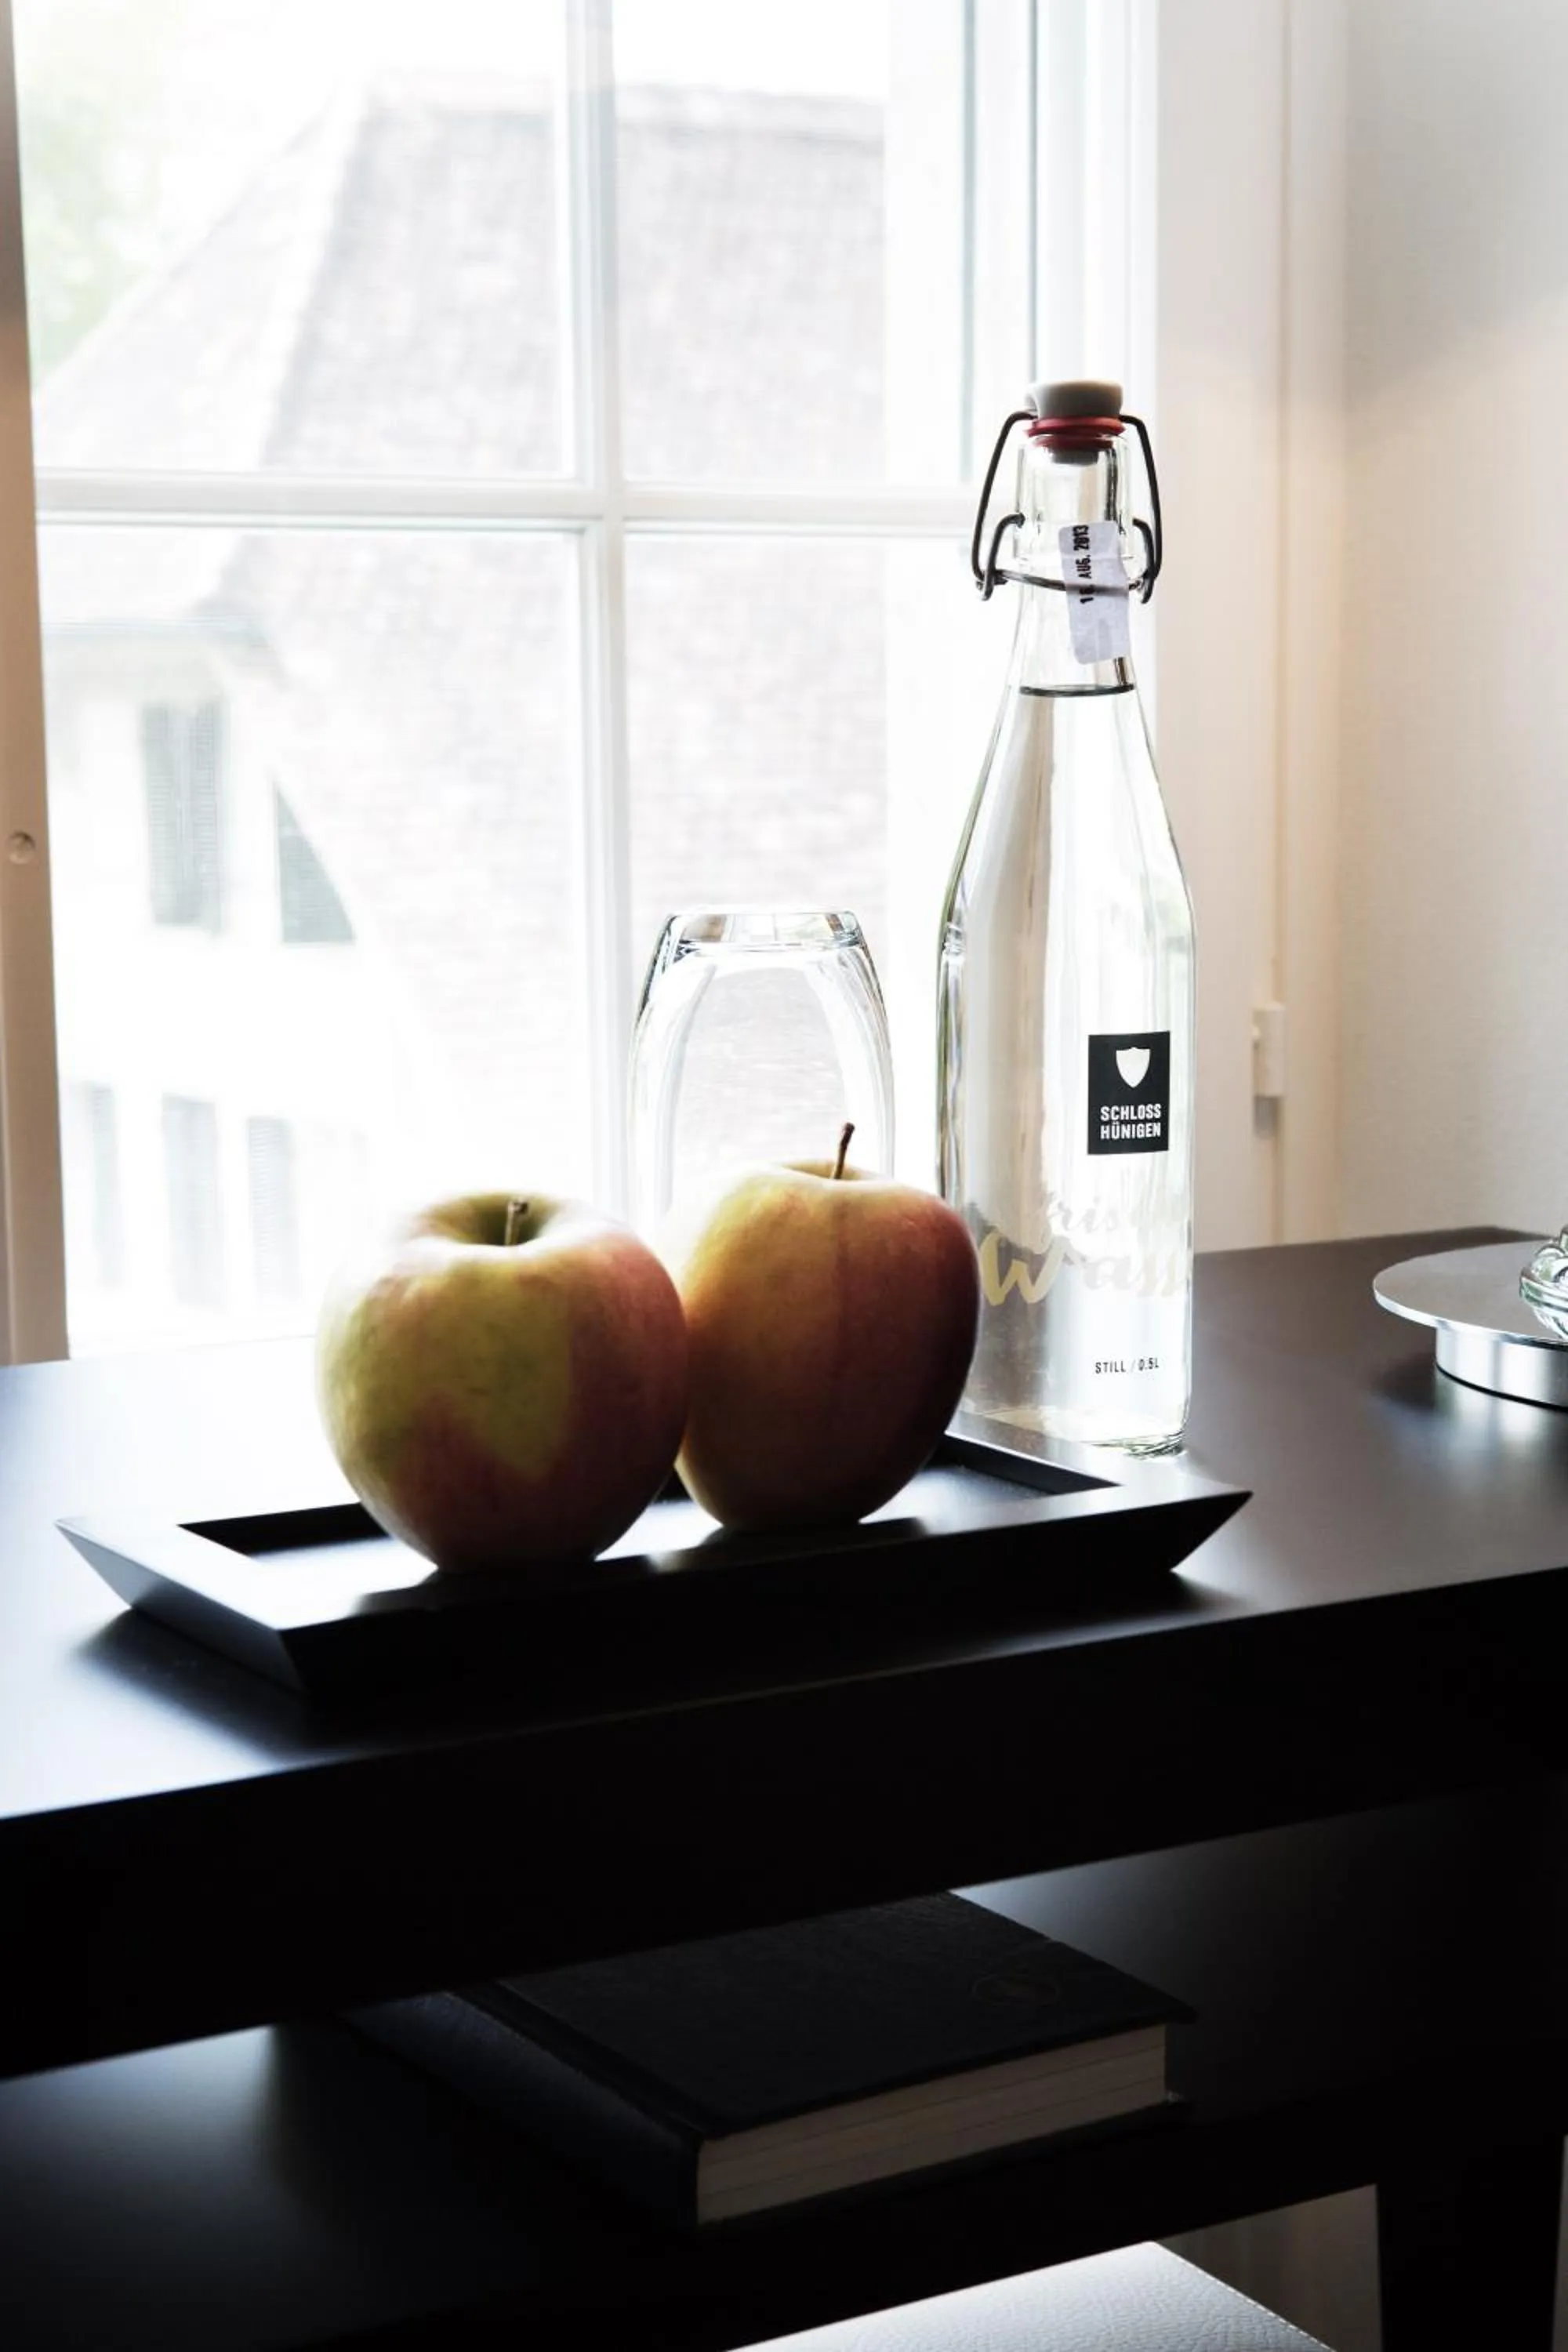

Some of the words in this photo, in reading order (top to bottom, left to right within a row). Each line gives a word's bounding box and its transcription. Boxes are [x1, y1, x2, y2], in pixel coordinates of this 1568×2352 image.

[1073, 524, 1090, 551] 2013
[1075, 554, 1092, 579] AUG.
[1100, 1103, 1162, 1122] SCHLOSS
[1100, 1121, 1162, 1141] HÜNIGEN
[1094, 1360, 1126, 1374] STILL
[1138, 1357, 1159, 1371] 0.5L
